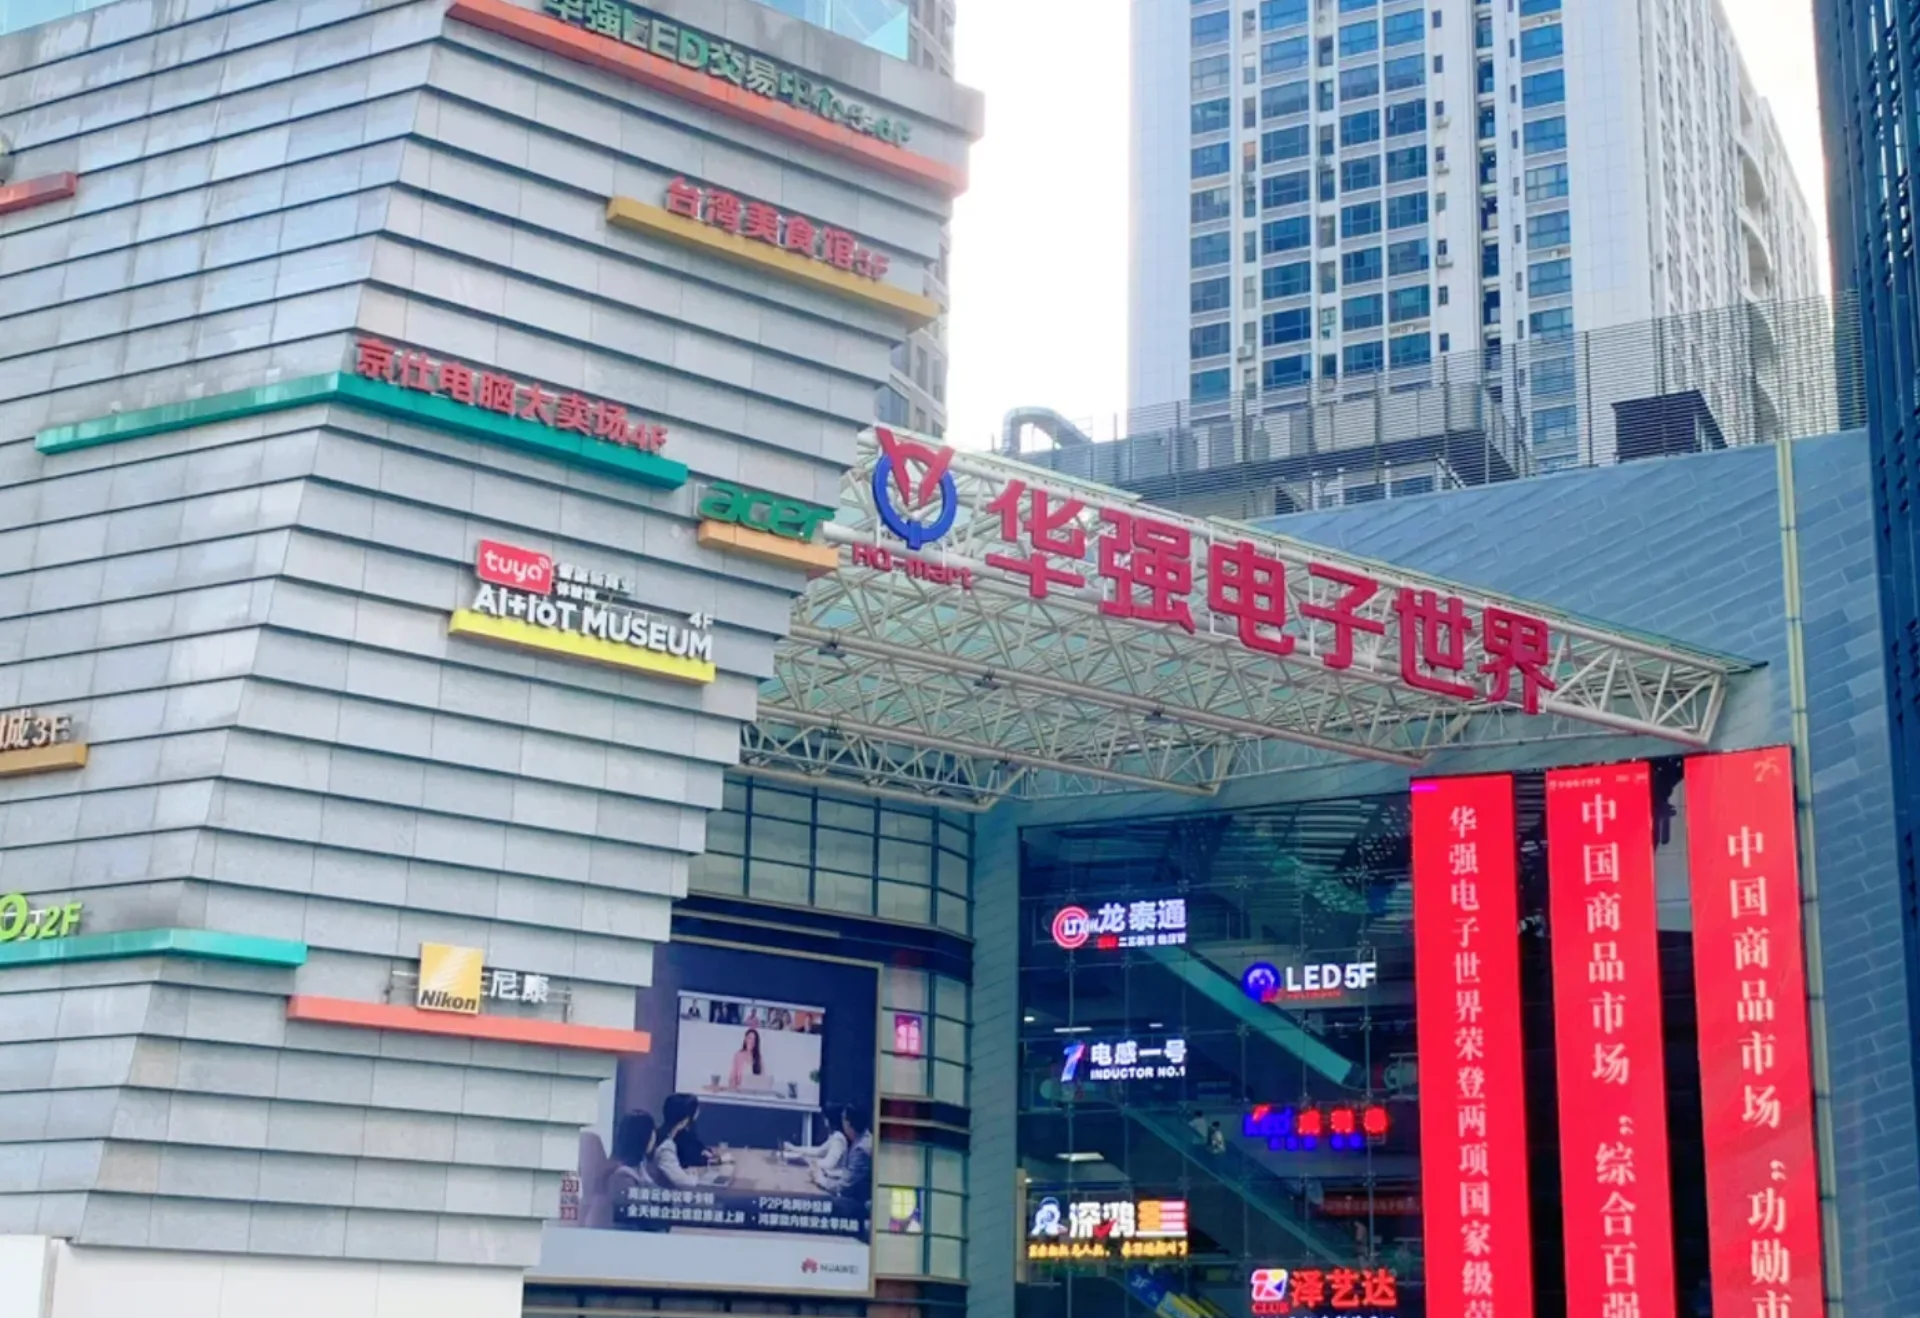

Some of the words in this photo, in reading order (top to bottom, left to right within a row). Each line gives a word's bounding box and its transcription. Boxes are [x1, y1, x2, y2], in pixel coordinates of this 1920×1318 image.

[699, 481, 835, 543] acer
[484, 550, 544, 582] tuya
[986, 481, 1556, 715] 华强电子世界
[582, 606, 713, 661] MUSEUM
[689, 611, 714, 629] 4F
[1098, 899, 1186, 933] 龙泰通
[420, 989, 477, 1010] Nikon
[490, 971, 549, 1004] 尼康
[1091, 1039, 1187, 1066] 电感一号
[1090, 1066, 1154, 1080] INDUCTOR
[1290, 1268, 1396, 1308] 泽艺达
